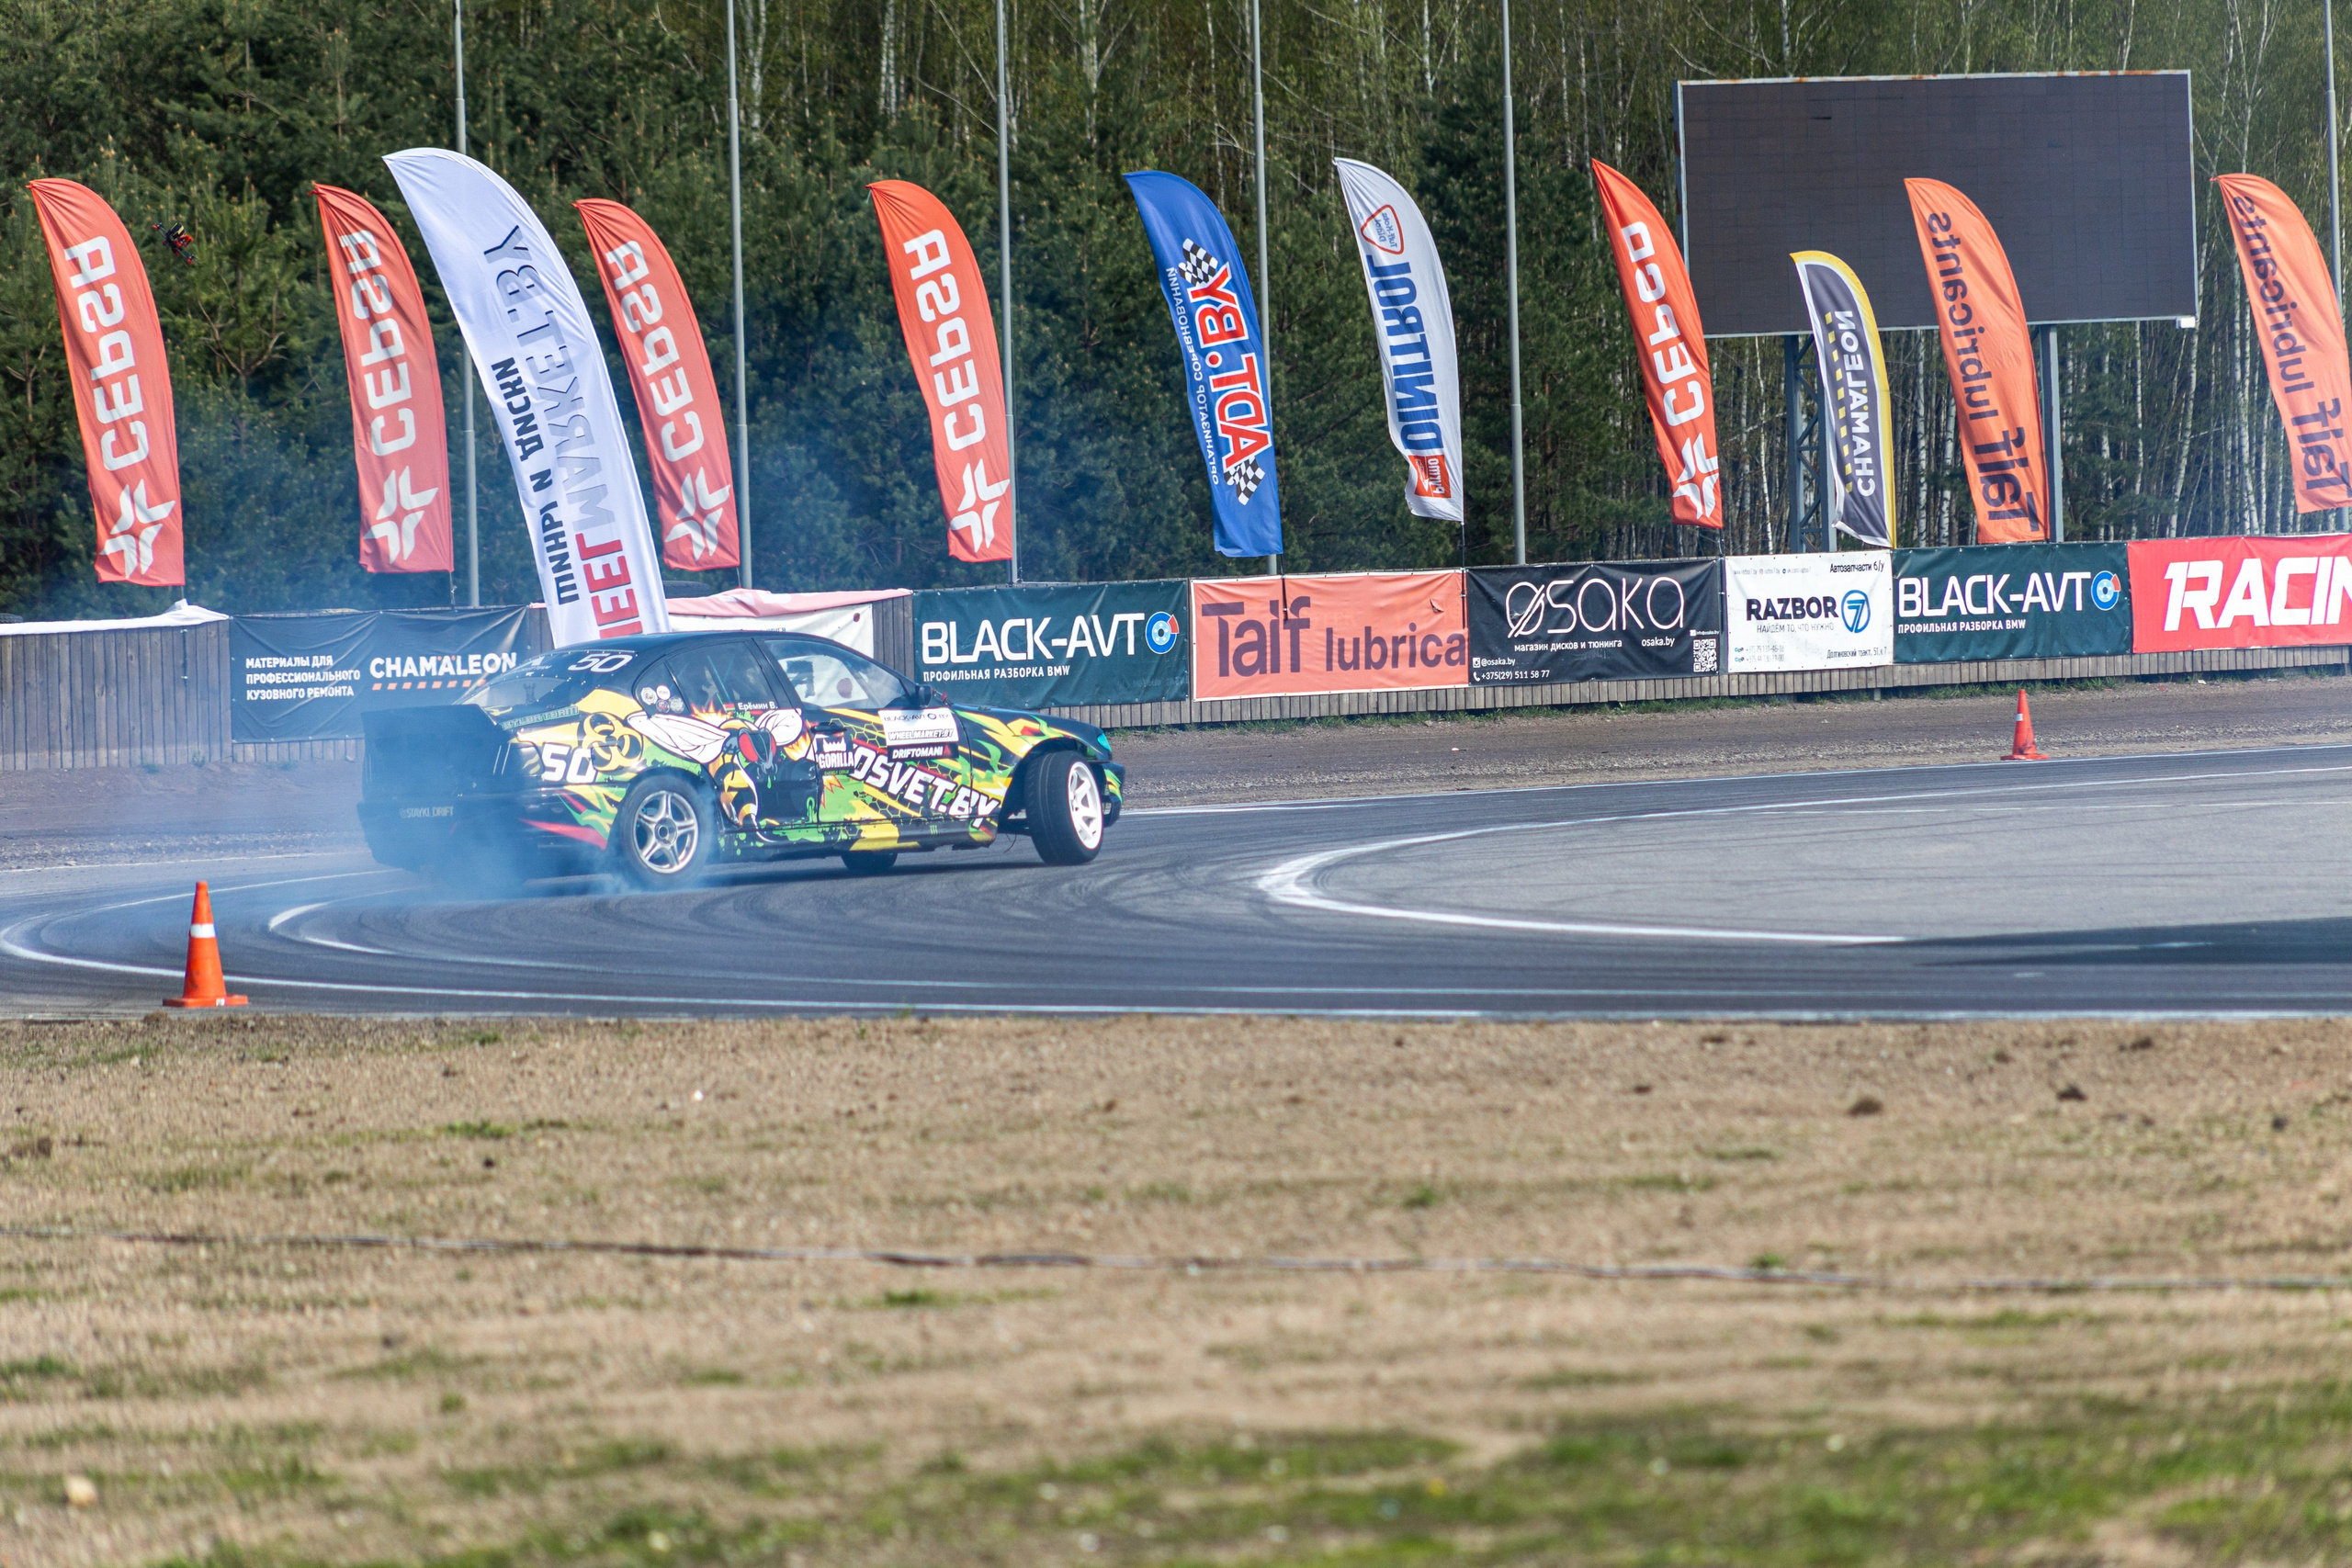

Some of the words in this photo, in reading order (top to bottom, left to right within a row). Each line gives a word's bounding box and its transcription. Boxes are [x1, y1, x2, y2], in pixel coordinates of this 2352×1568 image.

[1830, 563, 1871, 573] Автозапчасти
[1873, 560, 1885, 572] б/у
[1747, 596, 1839, 621] RAZBOR
[1898, 622, 1957, 634] ПРОФИЛЬНАЯ
[1960, 621, 2003, 631] РАЗБОРКА
[2006, 619, 2026, 629] BMW
[1202, 596, 1310, 677] Taif
[1641, 636, 1675, 648] osaka.by
[1514, 643, 1548, 652] магазин
[1550, 642, 1578, 653] дисков
[1588, 639, 1623, 649] тюнинга
[245, 656, 310, 669] МАТЕРИАЛЫ
[311, 655, 334, 668] ДЛЯ
[568, 653, 633, 672] 50
[1481, 657, 1516, 667] @osaka.by
[246, 670, 360, 684] ПРОФЕССИОНАЛЬНОГО
[923, 669, 990, 682] ПРОФИЛЬНАЯ
[994, 667, 1045, 680] РАЗБОРКА
[1047, 665, 1070, 676] BMW
[1481, 671, 1513, 681] +375(29)
[1515, 671, 1529, 679] 511
[1531, 671, 1540, 679] 58
[1541, 670, 1550, 679] 77
[246, 687, 305, 700] КУЗОВНОГО
[307, 686, 355, 699] РЕМОНТА
[738, 703, 768, 712] Ерёмин
[541, 743, 597, 784] 50
[818, 751, 854, 769] GORILLA
